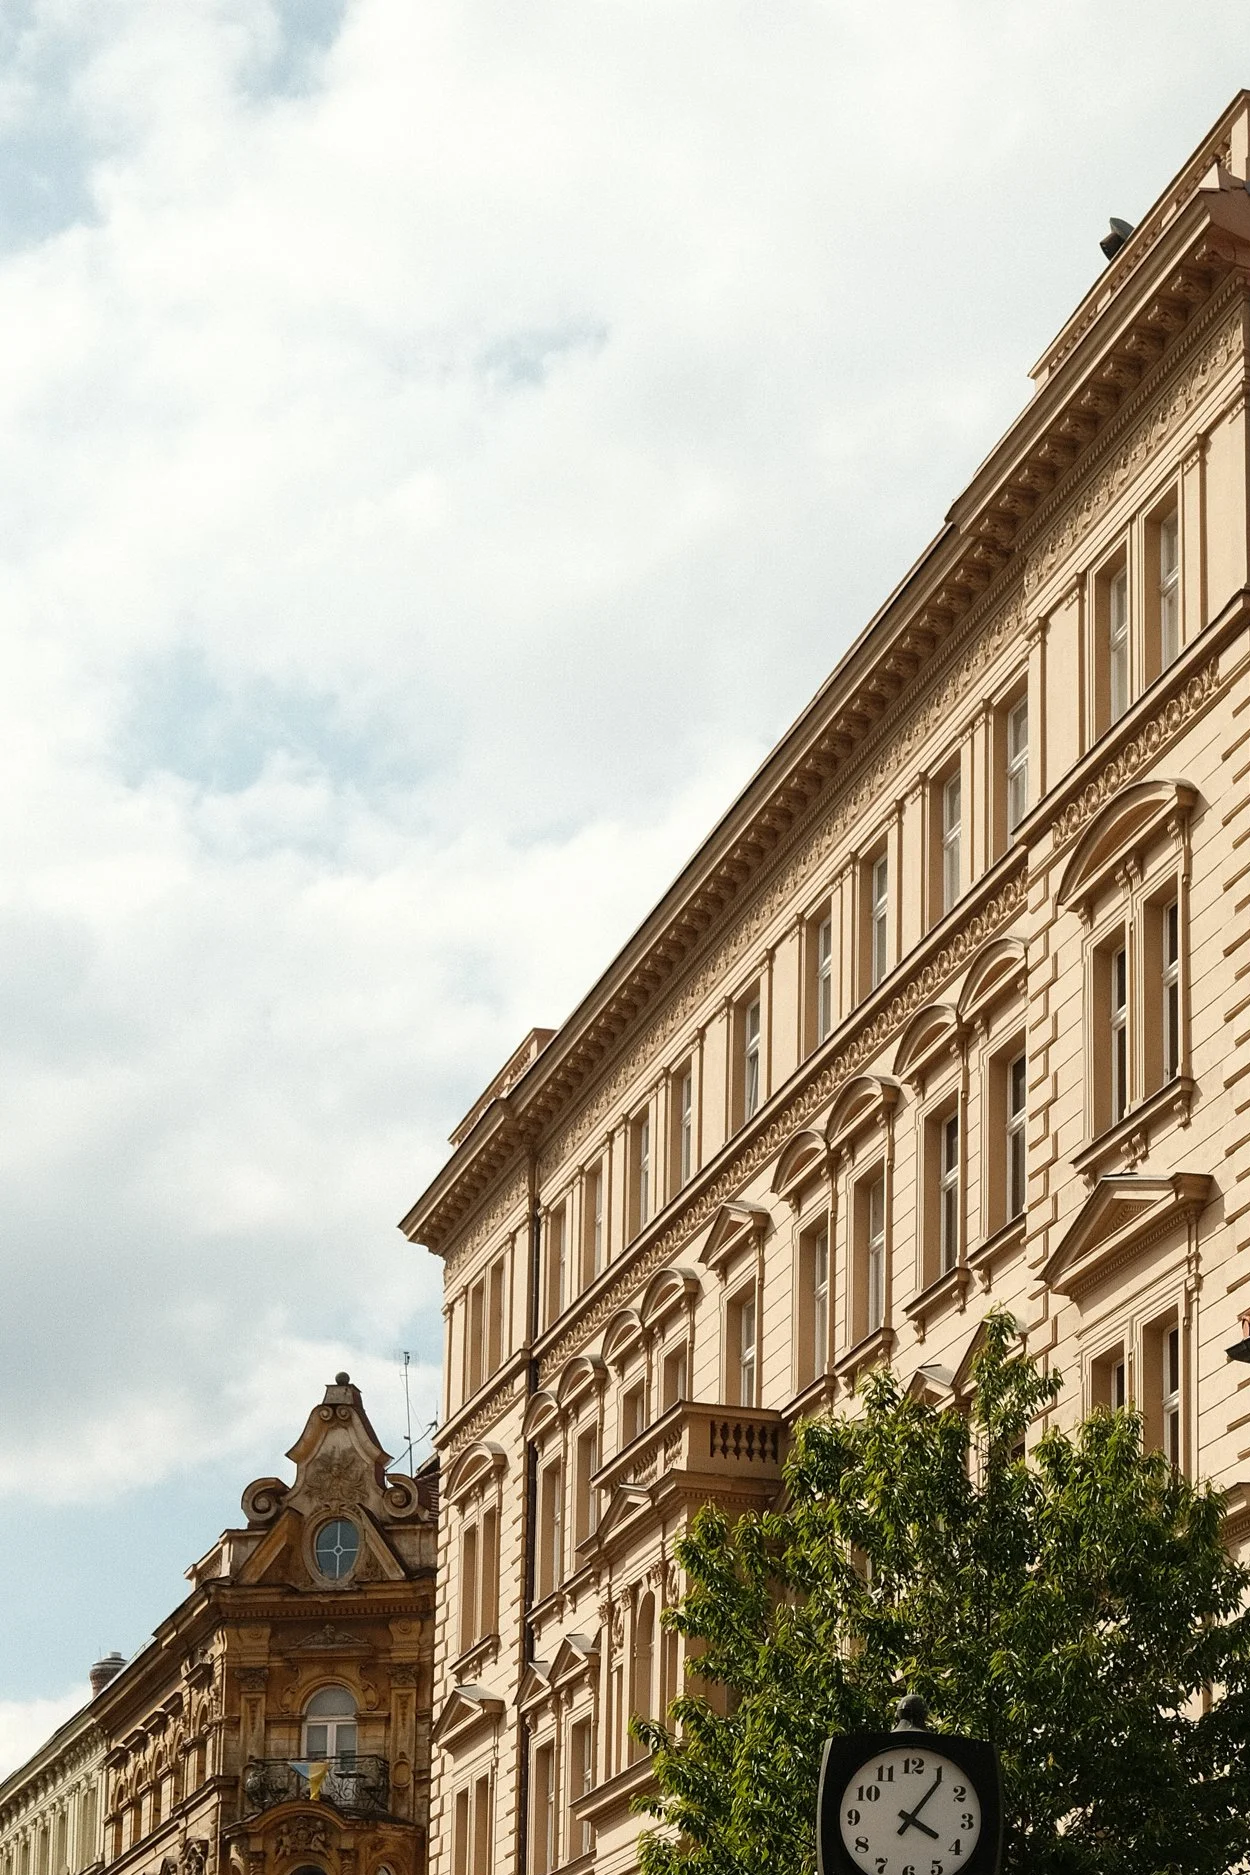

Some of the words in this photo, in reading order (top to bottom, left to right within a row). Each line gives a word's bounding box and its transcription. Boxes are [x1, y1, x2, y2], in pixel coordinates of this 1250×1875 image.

[875, 1765, 896, 1782] 11
[902, 1757, 925, 1775] 12
[934, 1765, 943, 1782] 1
[856, 1785, 881, 1802] 10
[953, 1785, 967, 1802] 2
[847, 1809, 861, 1826] 9
[960, 1813, 974, 1830] 3
[855, 1836, 870, 1853] 8
[948, 1838, 963, 1856] 4
[875, 1857, 888, 1874] 7
[930, 1860, 944, 1875] 5
